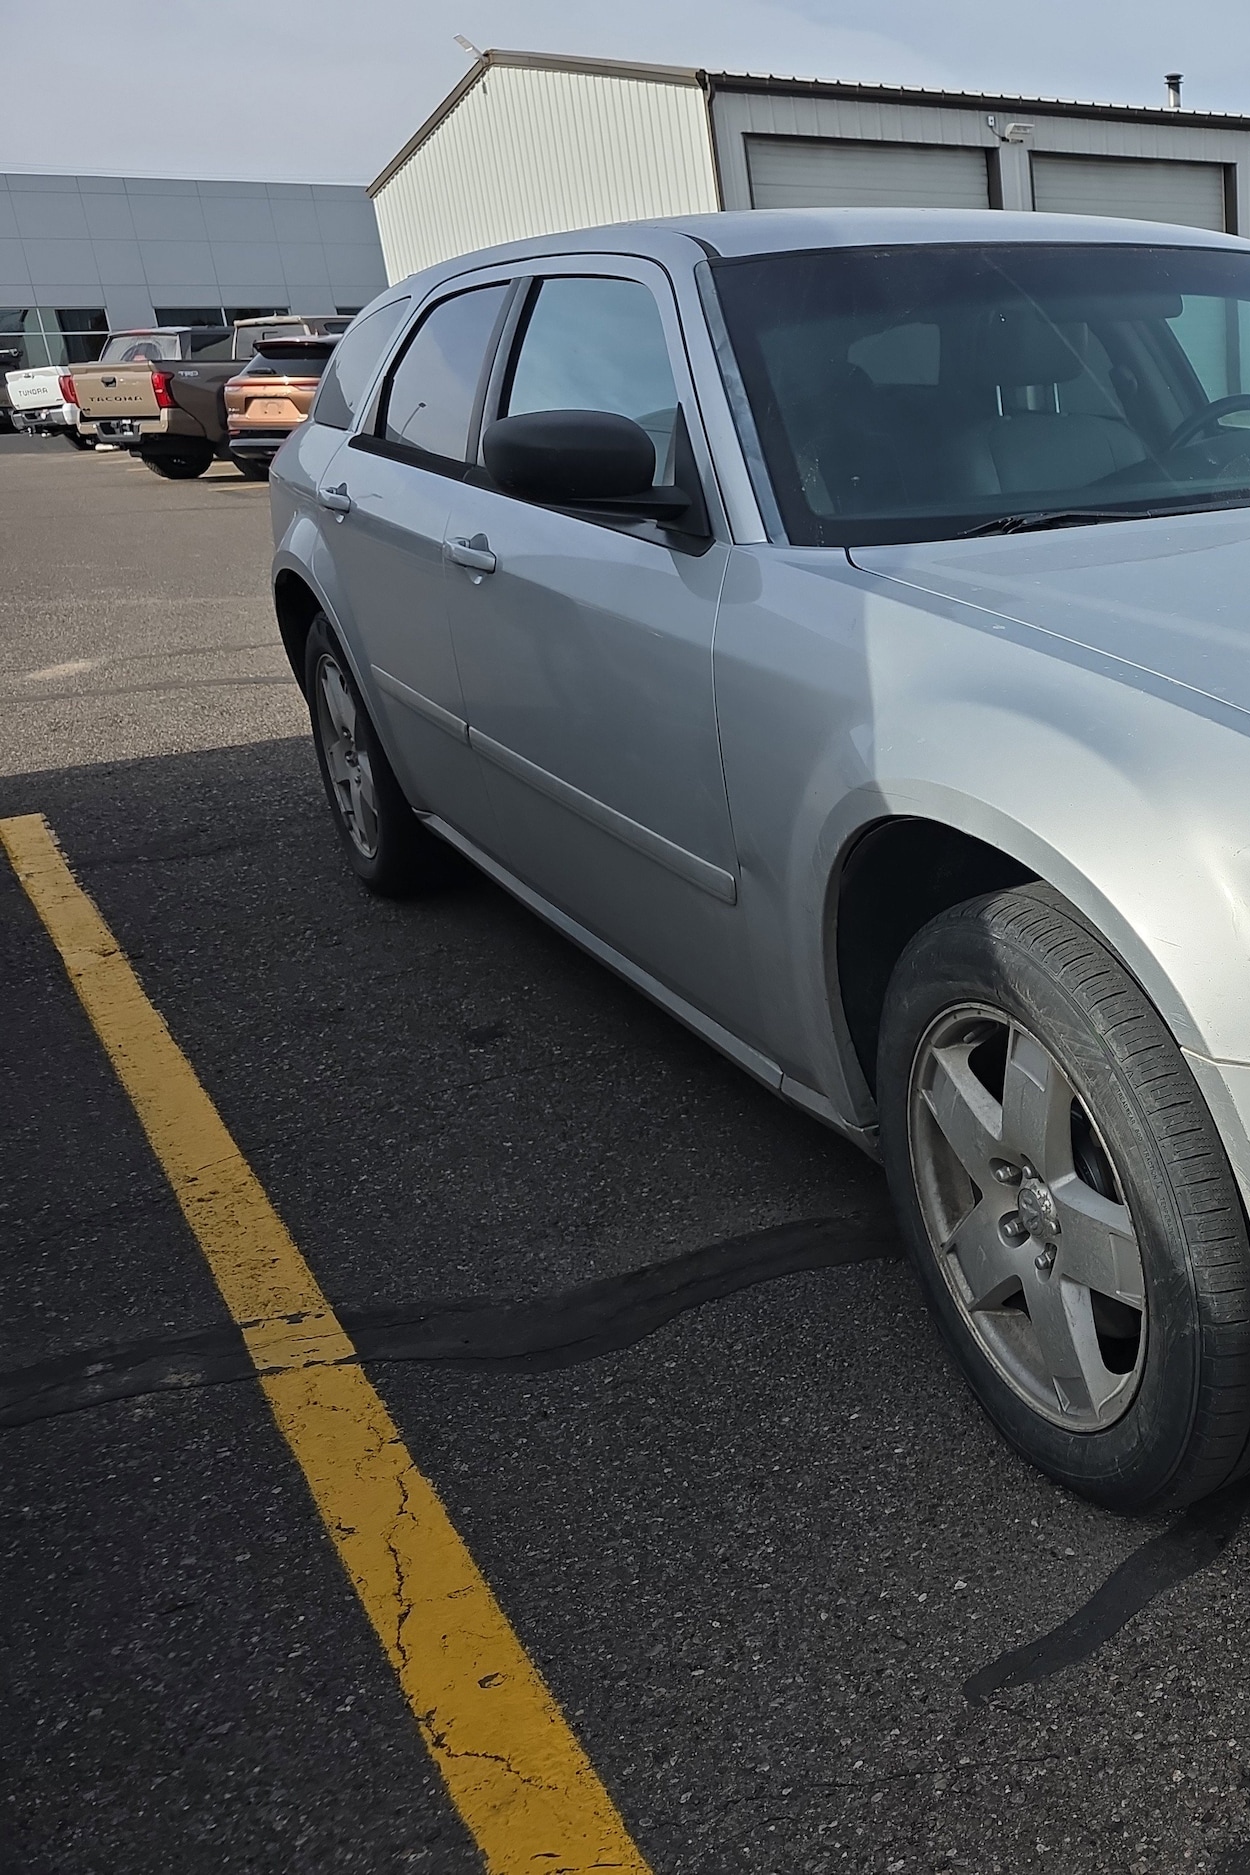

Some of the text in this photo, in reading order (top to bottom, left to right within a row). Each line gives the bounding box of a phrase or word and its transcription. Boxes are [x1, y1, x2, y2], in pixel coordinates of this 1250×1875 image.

[18, 387, 49, 397] TUNDRA
[1115, 1088, 1137, 1126] TREADWEAR
[1143, 1149, 1158, 1180] TRACTION
